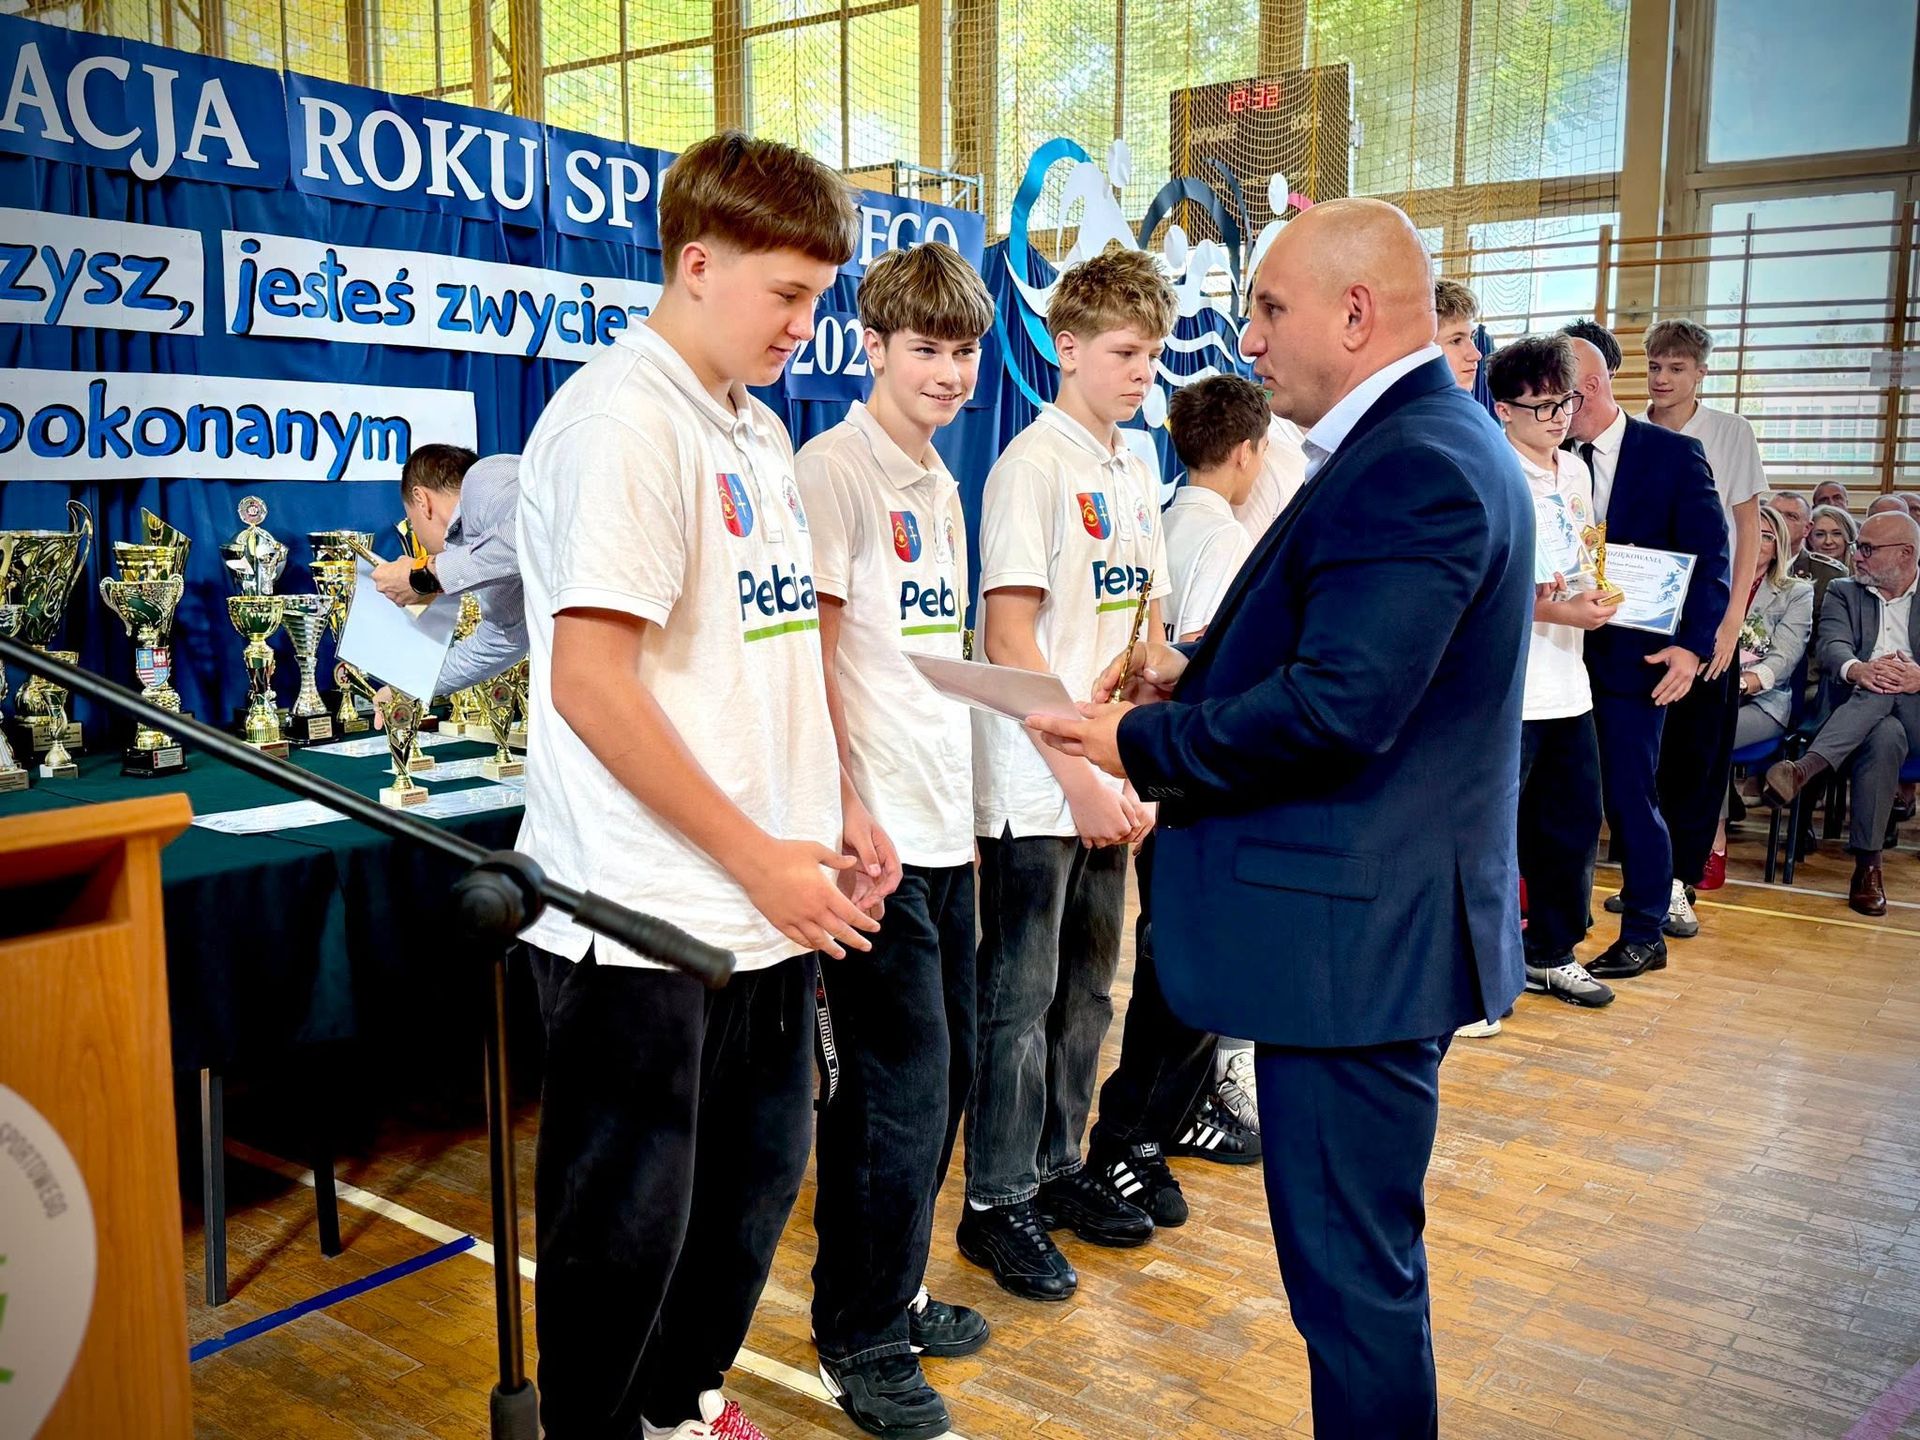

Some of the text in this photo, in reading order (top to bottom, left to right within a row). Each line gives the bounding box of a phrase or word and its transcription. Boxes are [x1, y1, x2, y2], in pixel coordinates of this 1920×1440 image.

[2, 42, 666, 229] ACJA ROKU SP
[231, 238, 416, 336] jesteś
[436, 283, 650, 357] zwycie
[790, 315, 876, 377] 202
